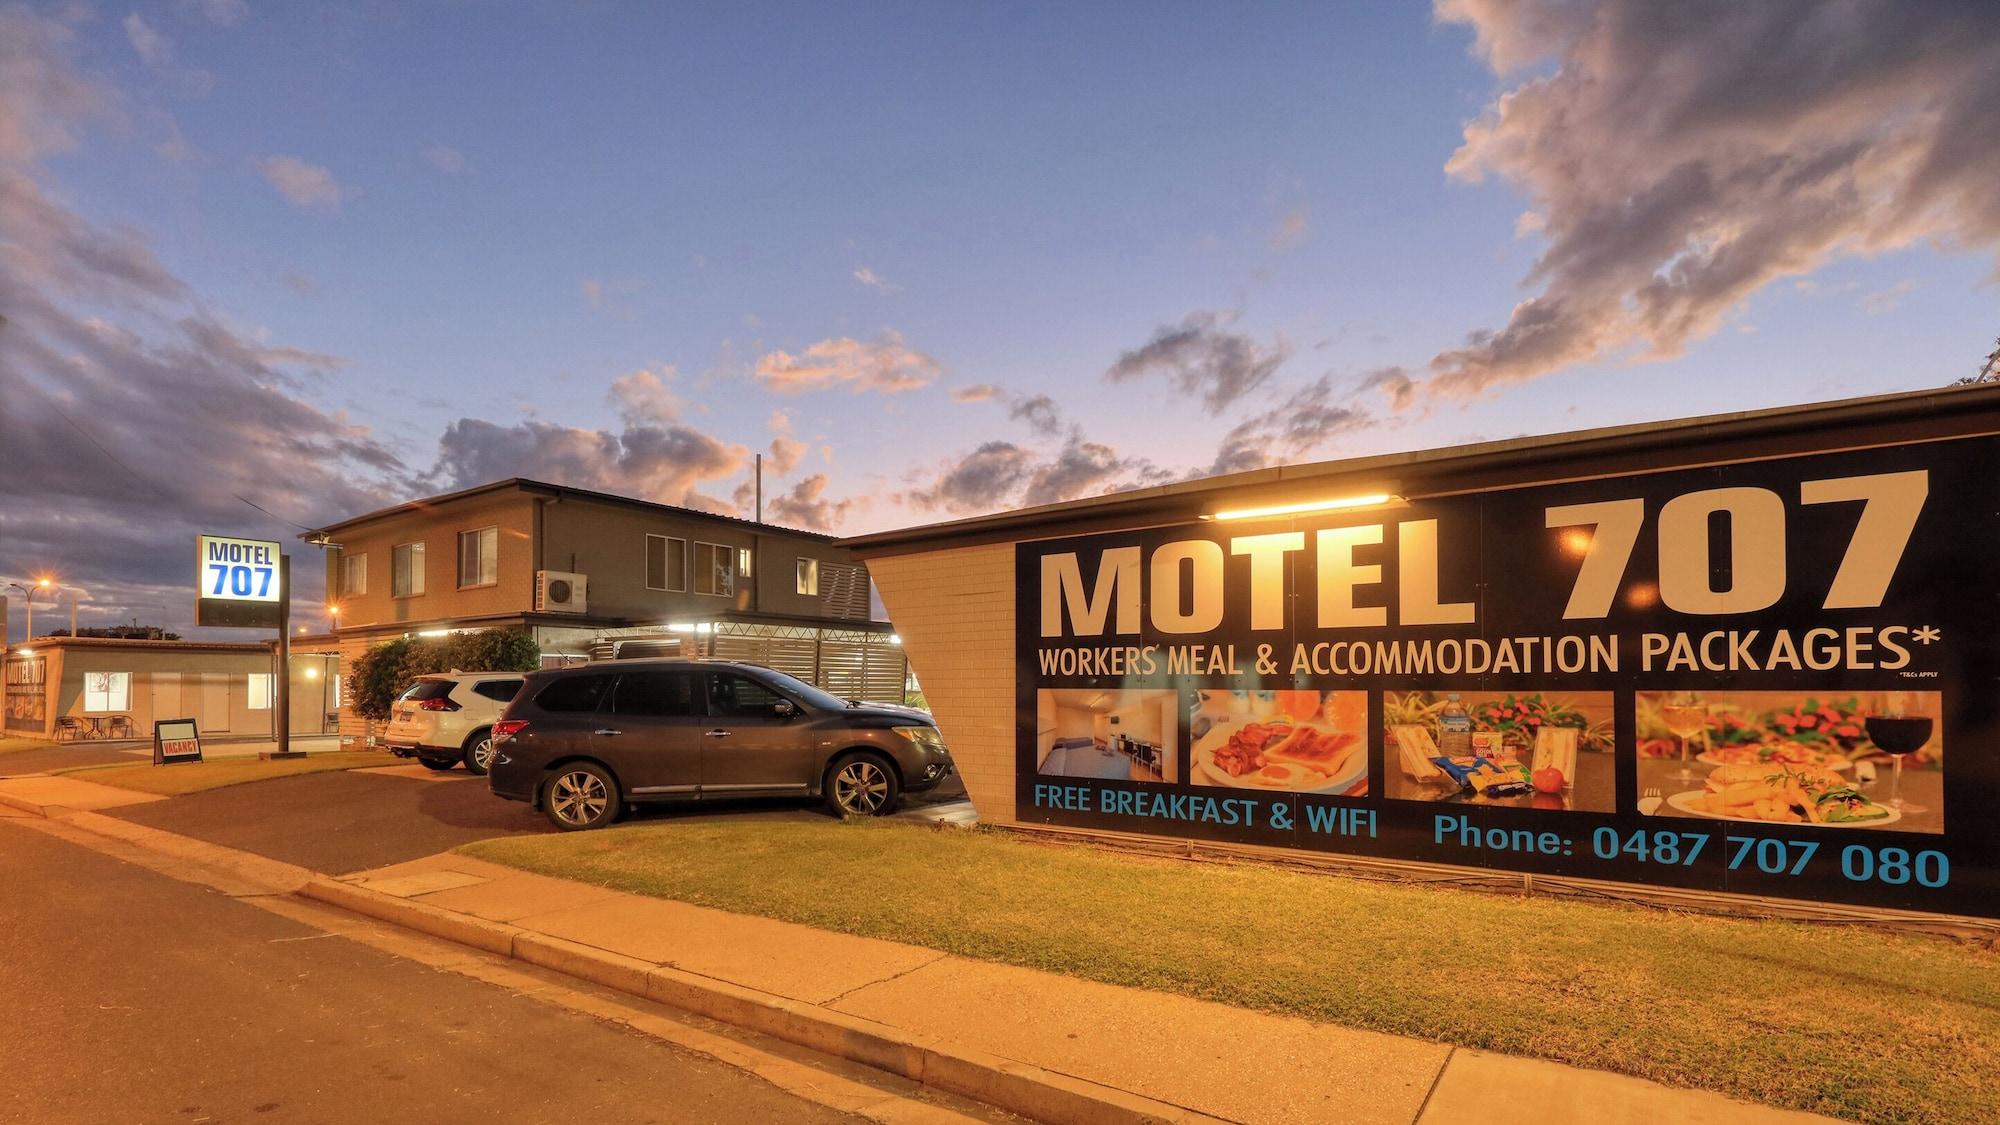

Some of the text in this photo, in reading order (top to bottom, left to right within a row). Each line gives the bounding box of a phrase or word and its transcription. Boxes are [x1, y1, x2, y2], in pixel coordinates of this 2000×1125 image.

[209, 541, 273, 565] MOTEL
[1040, 469, 1929, 638] MOTEL 707
[209, 564, 272, 597] 707
[6, 659, 45, 684] MOTEL 707
[1167, 644, 1243, 675] MEAL
[1255, 643, 1278, 675] &
[1290, 635, 1618, 675] ACCOMMODATION
[163, 740, 197, 754] VACANCY
[1034, 784, 1950, 888] FREE BREAKFAST & WIFI Phone: 0487 707 080
